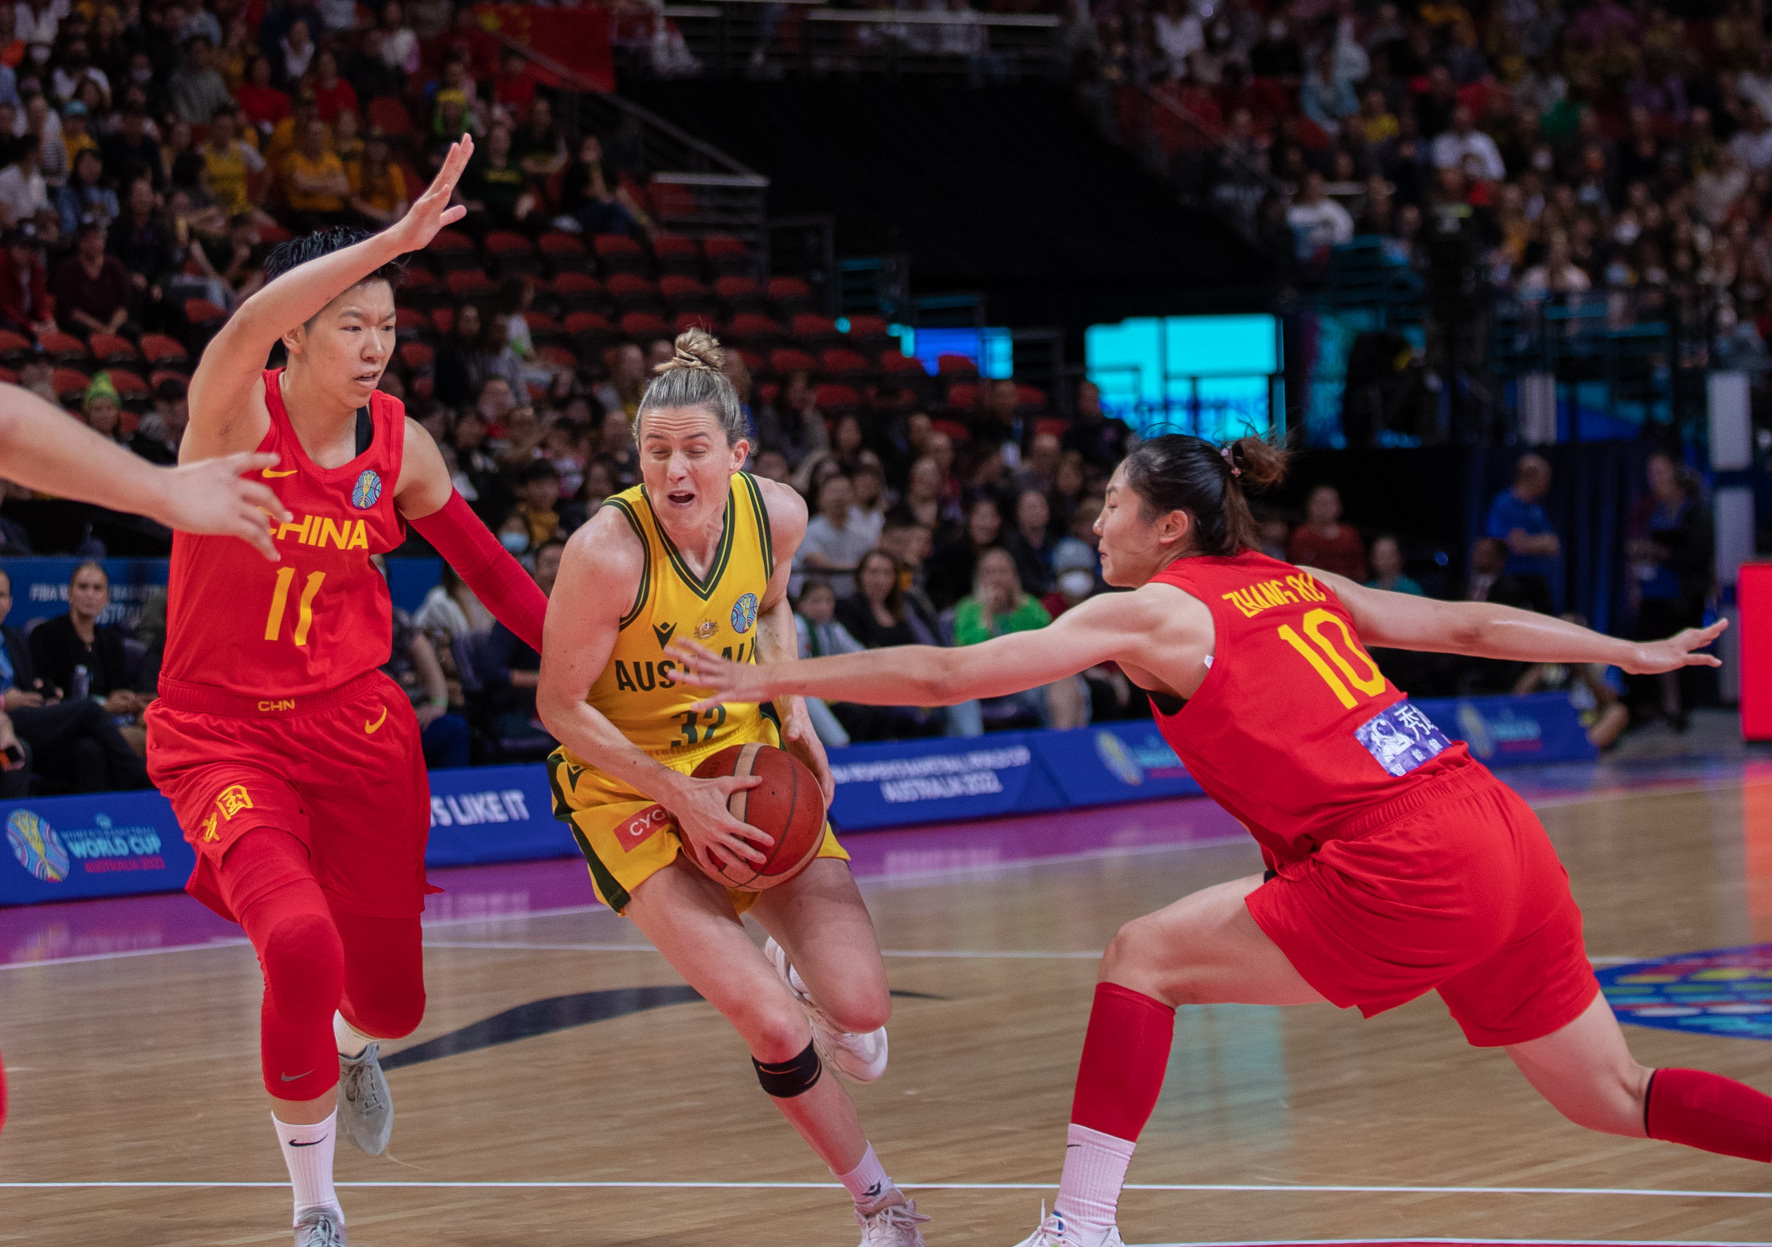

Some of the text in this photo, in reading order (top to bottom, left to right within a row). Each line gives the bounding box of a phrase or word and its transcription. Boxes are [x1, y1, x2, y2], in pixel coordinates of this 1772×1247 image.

[256, 506, 369, 550] HINA
[264, 566, 326, 646] 11
[1221, 579, 1300, 618] ZHANG
[1277, 608, 1386, 710] 10
[257, 699, 296, 712] CHN
[670, 703, 727, 748] 32
[445, 791, 509, 825] LIKE
[500, 789, 530, 821] IT
[66, 832, 162, 859] WORLD CUP
